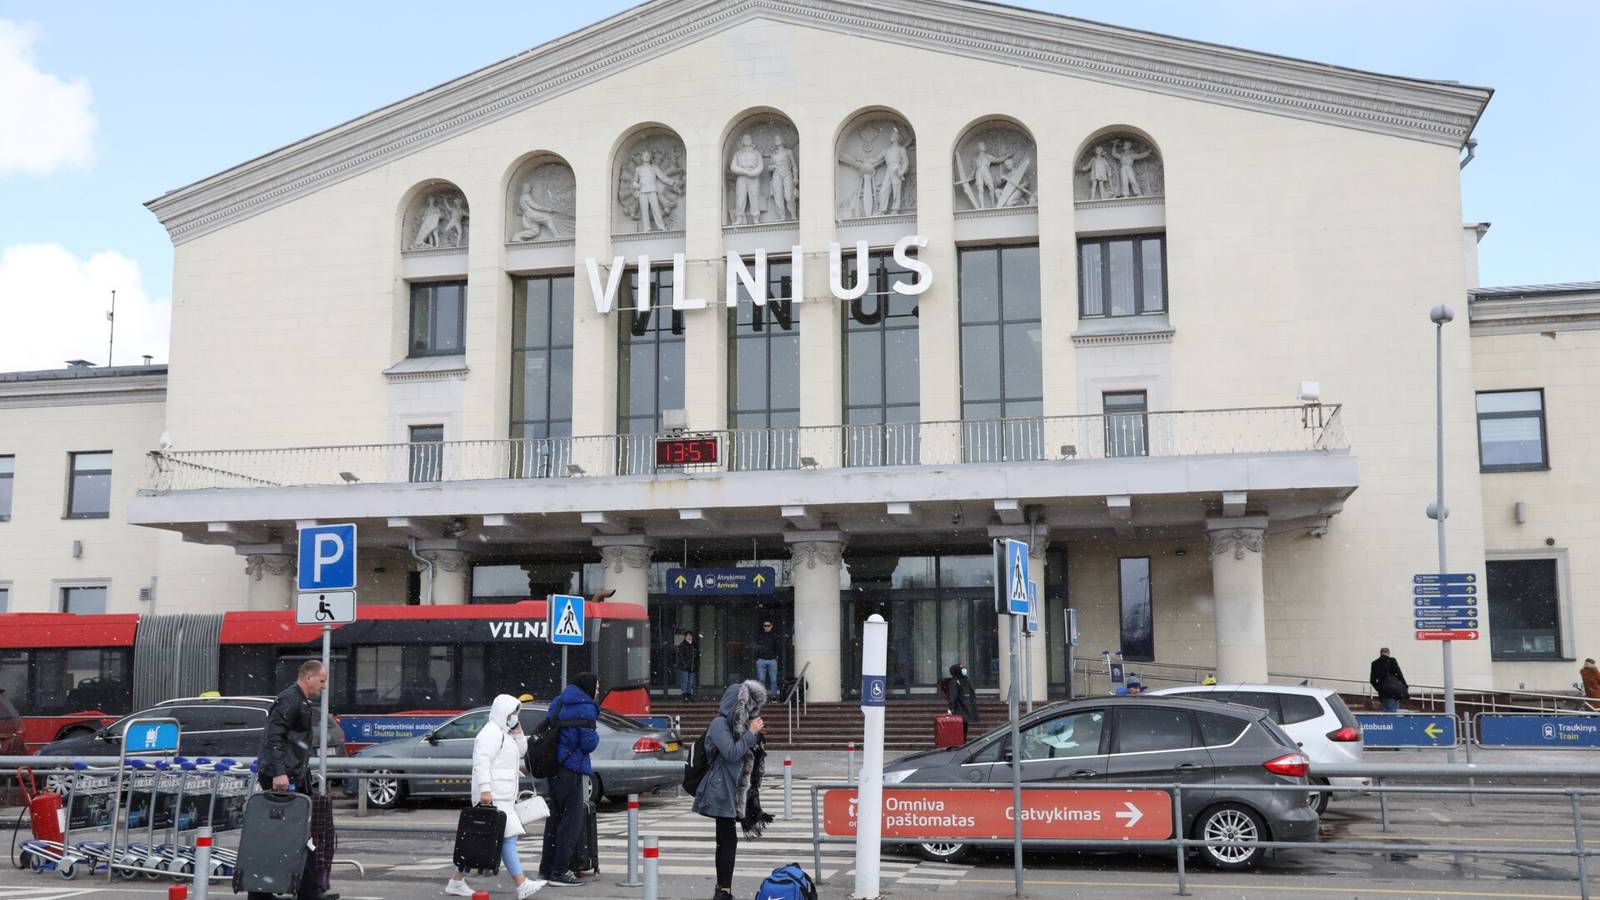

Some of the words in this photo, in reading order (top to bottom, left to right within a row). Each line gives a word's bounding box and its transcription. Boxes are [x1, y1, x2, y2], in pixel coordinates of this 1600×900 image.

[585, 235, 933, 313] VILNIUS
[666, 441, 715, 462] 13:57
[314, 533, 344, 582] P
[694, 574, 704, 589] A
[1359, 722, 1393, 730] utobusai
[1558, 723, 1597, 733] Traukinys
[1559, 732, 1579, 740] Train
[886, 797, 945, 811] Omniva
[886, 813, 975, 828] paštomatas
